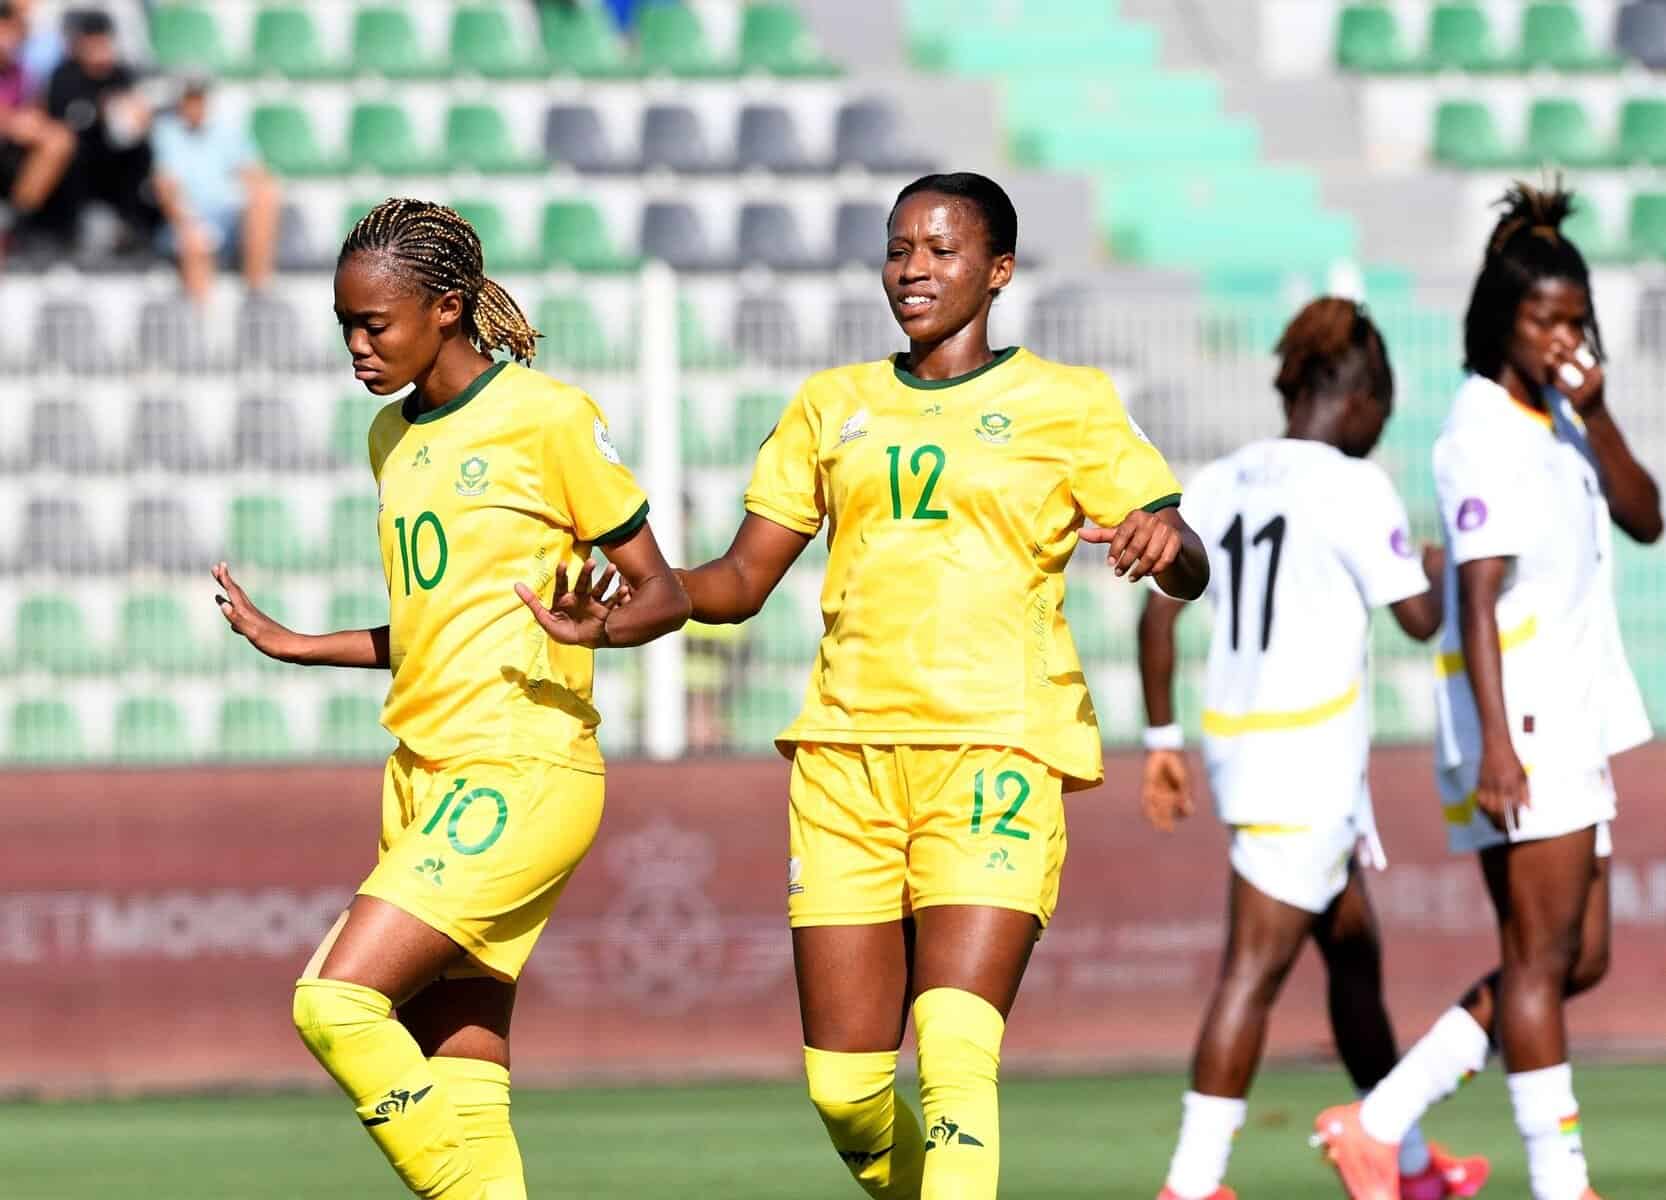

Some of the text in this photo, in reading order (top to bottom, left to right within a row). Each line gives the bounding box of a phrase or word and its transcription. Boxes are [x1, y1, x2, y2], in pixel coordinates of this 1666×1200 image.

[885, 443, 949, 521] 12
[394, 510, 448, 597] 10
[1219, 512, 1287, 653] 11
[421, 778, 508, 856] 10
[970, 767, 1031, 841] 12
